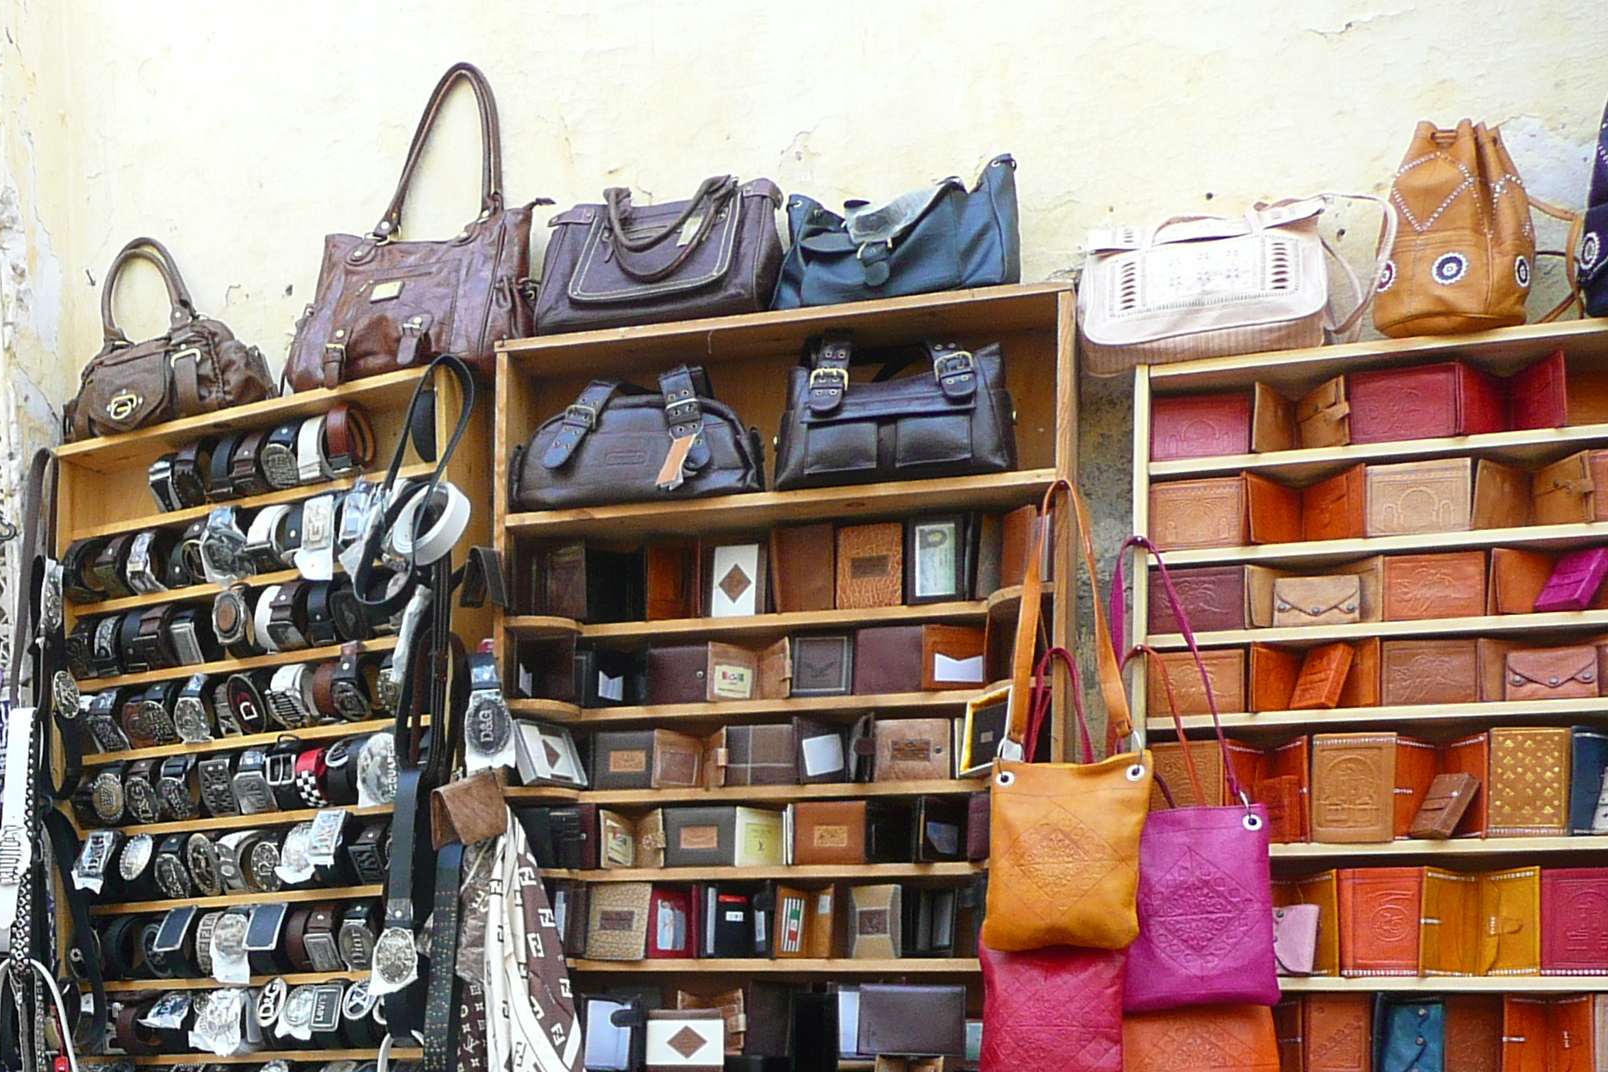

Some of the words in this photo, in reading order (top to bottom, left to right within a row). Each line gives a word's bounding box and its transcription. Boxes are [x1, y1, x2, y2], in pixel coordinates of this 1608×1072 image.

[478, 709, 494, 742] D&G
[352, 929, 367, 964] Dior
[259, 983, 279, 1017] D&G
